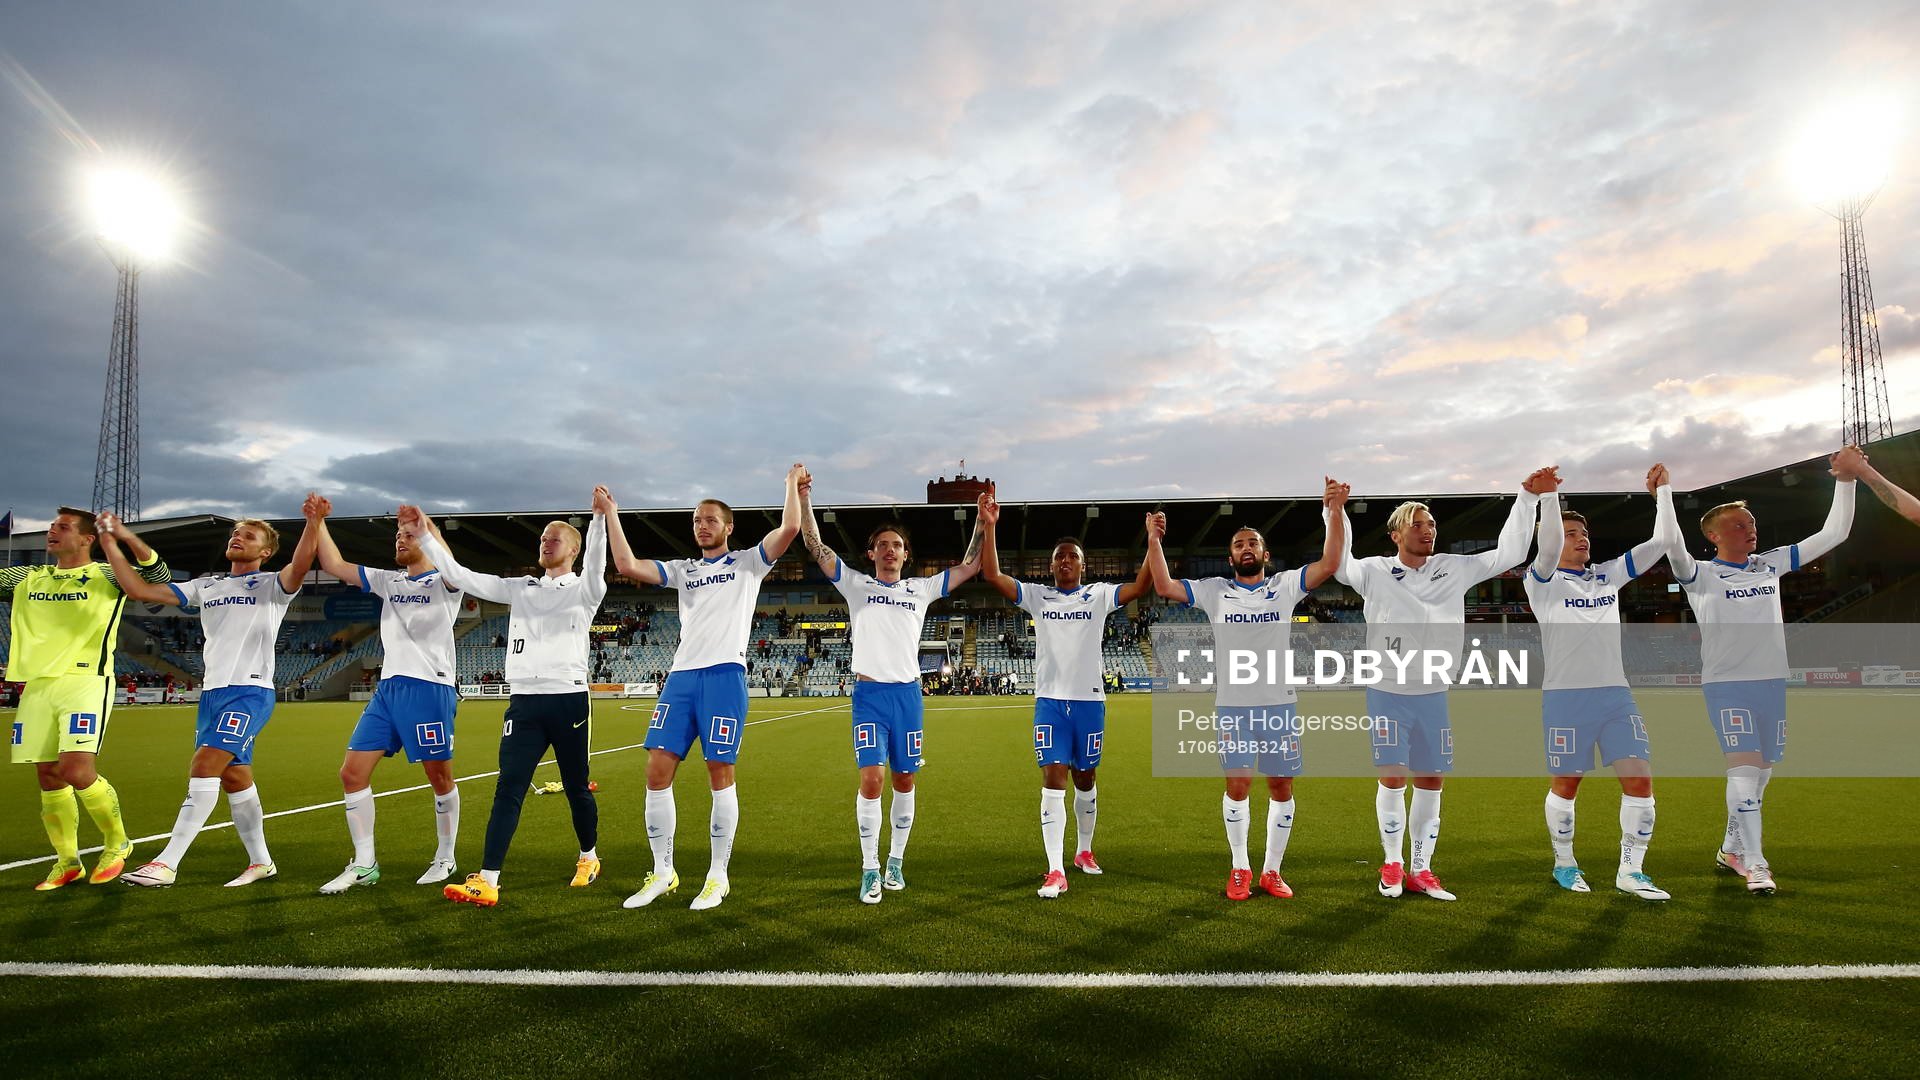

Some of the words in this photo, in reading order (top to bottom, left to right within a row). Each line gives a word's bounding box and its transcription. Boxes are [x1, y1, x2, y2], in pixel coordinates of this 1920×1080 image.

[685, 572, 736, 590] HOLMEN
[28, 592, 88, 602] HOLMEN
[1725, 586, 1776, 600] HOLMEN
[204, 596, 257, 609] HOLMEN
[1565, 594, 1617, 608] HOLMEN
[1042, 611, 1092, 620] HOLMEN
[1225, 611, 1280, 623] HOLMEN
[512, 638, 525, 654] 10
[1385, 636, 1402, 655] 14
[1813, 672, 1847, 680] XERVON
[1723, 734, 1739, 748] 18
[1549, 755, 1560, 768] 10
